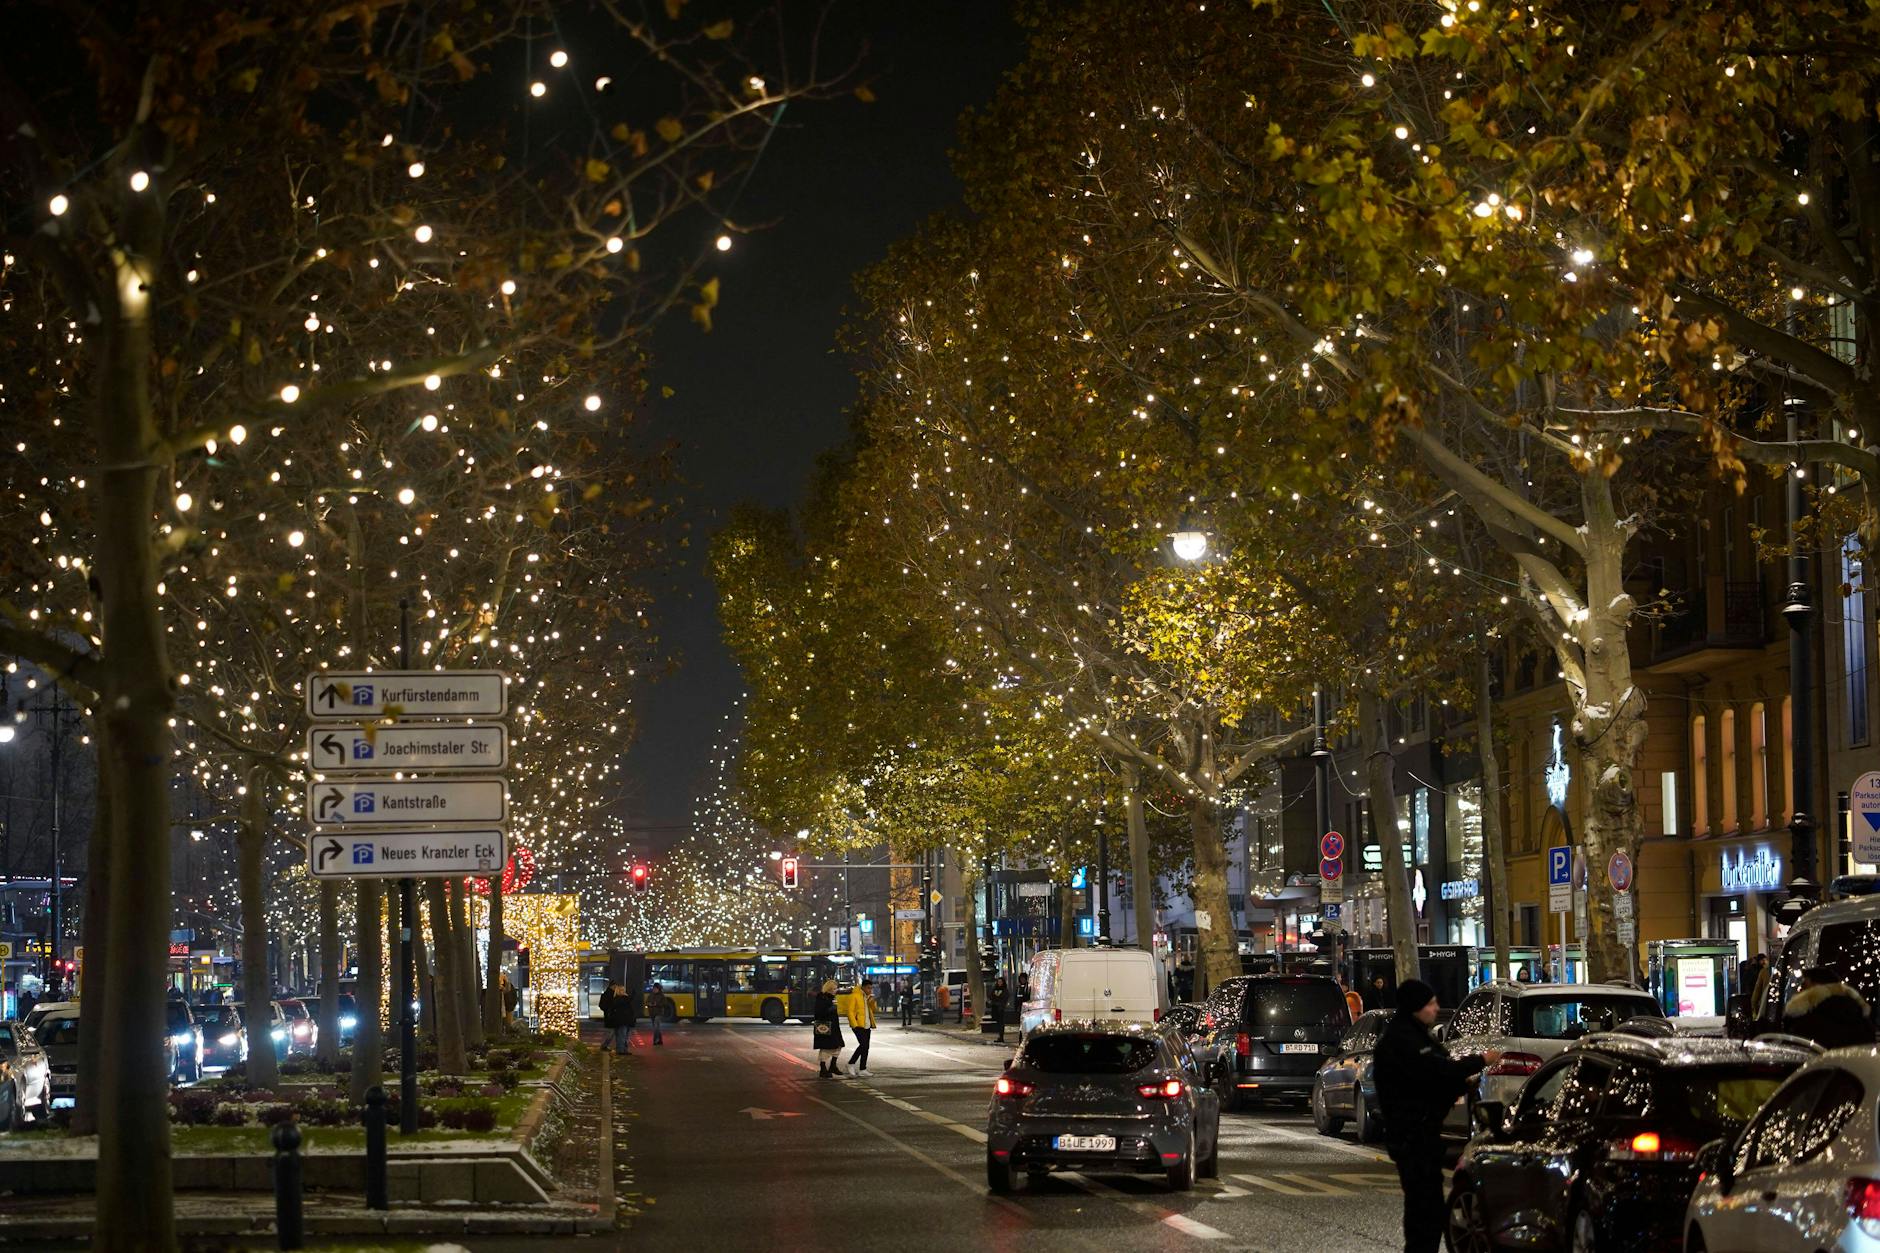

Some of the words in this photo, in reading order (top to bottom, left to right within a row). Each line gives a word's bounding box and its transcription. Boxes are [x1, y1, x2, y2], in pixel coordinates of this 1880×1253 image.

[381, 688, 480, 702] Kurfürstendamm
[383, 740, 465, 755] Joachimstaler
[471, 741, 491, 754] Str.
[382, 794, 447, 809] Kantstraße
[381, 847, 417, 860] Neues
[422, 845, 470, 858] Kranzler
[474, 844, 496, 858] Eck
[1553, 851, 1566, 881] P
[1082, 919, 1091, 933] U
[1088, 1138, 1114, 1148] 1999
